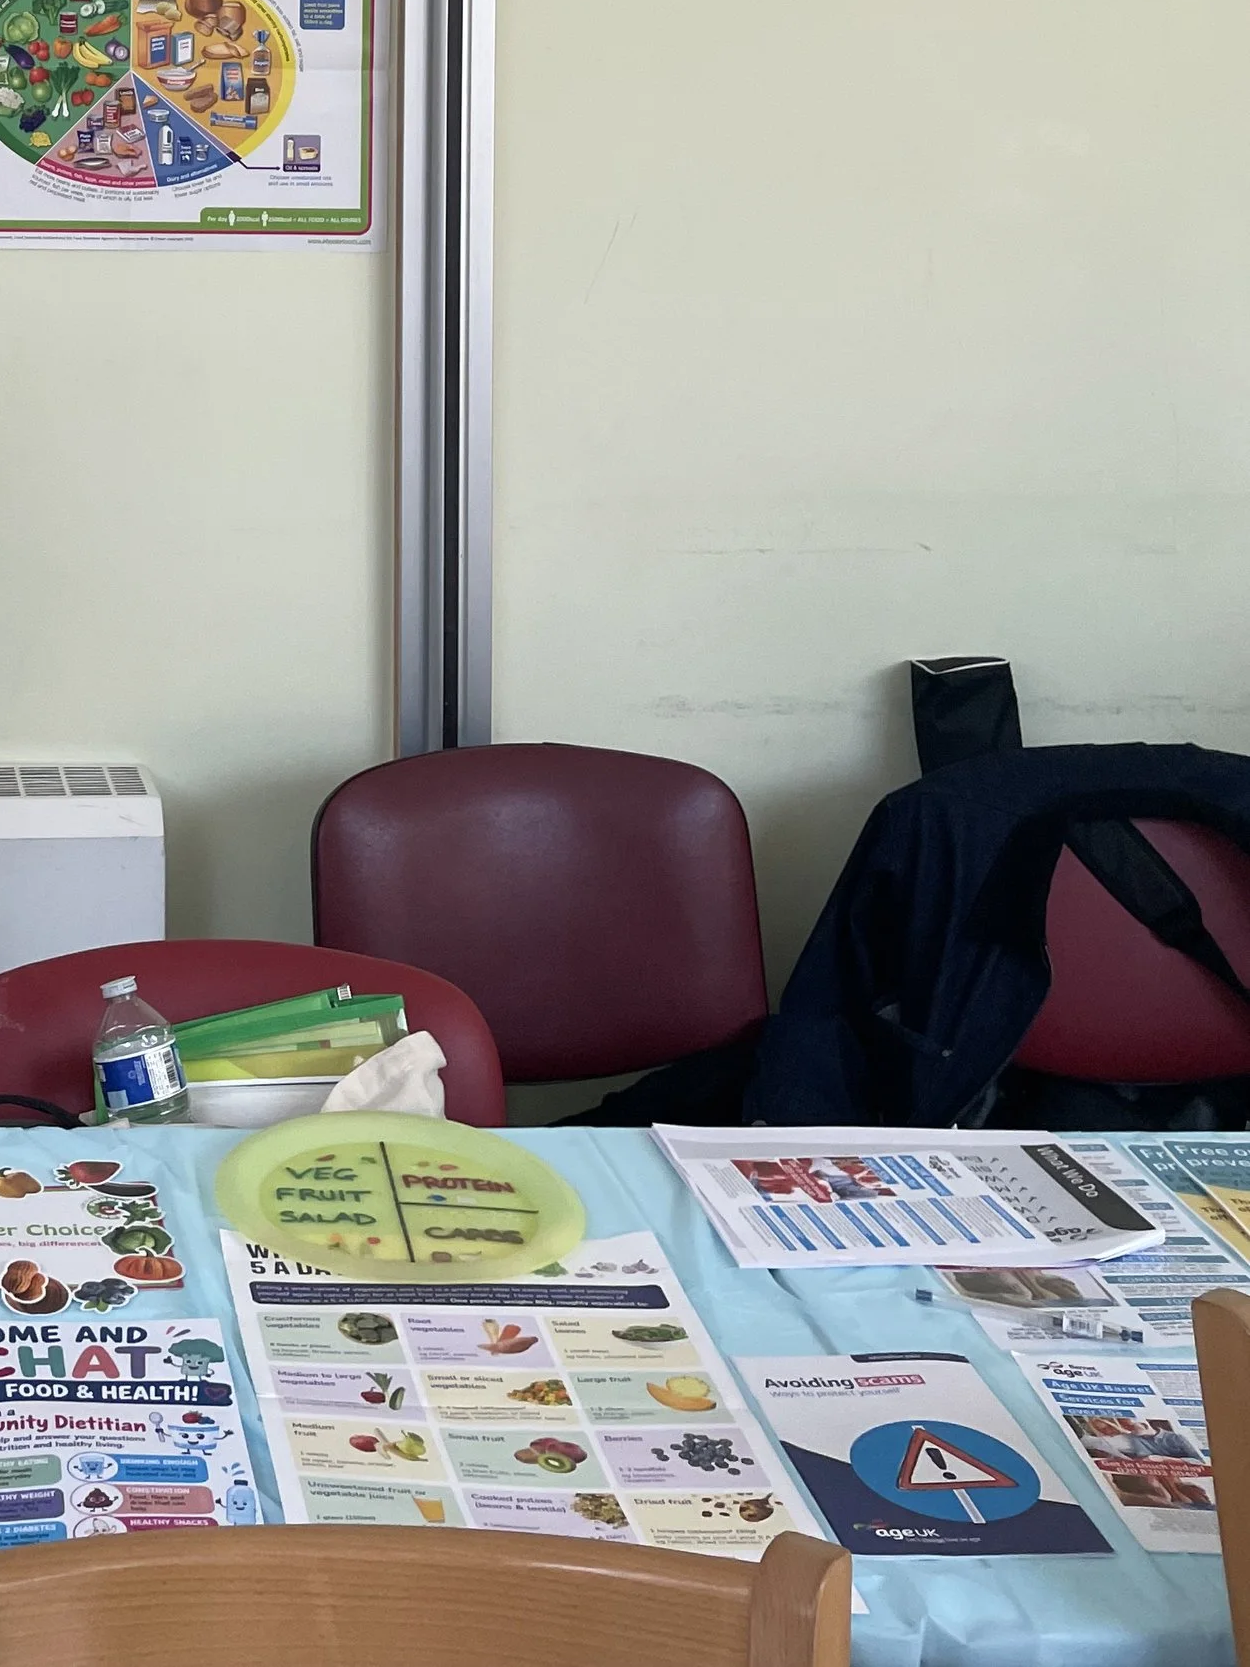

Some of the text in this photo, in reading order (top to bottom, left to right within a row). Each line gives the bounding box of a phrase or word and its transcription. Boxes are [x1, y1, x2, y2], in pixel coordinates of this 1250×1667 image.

[1174, 1145, 1229, 1155] Free
[286, 1166, 358, 1181] VEG
[1037, 1146, 1099, 1198] What We Do
[402, 1174, 515, 1193] PROTEIN
[276, 1187, 372, 1202] FRUIT
[280, 1210, 377, 1226] SALAD
[250, 1261, 290, 1274] 5 A
[75, 1326, 148, 1344] AND
[765, 1375, 922, 1390] Avoiding scams
[1051, 1380, 1151, 1394] Age UK Barnet
[5, 1384, 70, 1398] FOOD
[76, 1385, 94, 1399] &
[101, 1384, 199, 1402] HEALTH!
[770, 1390, 800, 1398] Ways
[817, 1390, 855, 1398] protect
[859, 1388, 900, 1397] yourself
[1059, 1394, 1137, 1406] Services for
[54, 1415, 147, 1433] Dietitian
[33, 1441, 52, 1449] and
[55, 1440, 92, 1449] healthy
[96, 1441, 125, 1449] living.
[604, 1435, 643, 1443] Berries
[20, 1490, 56, 1499] WEIGHT
